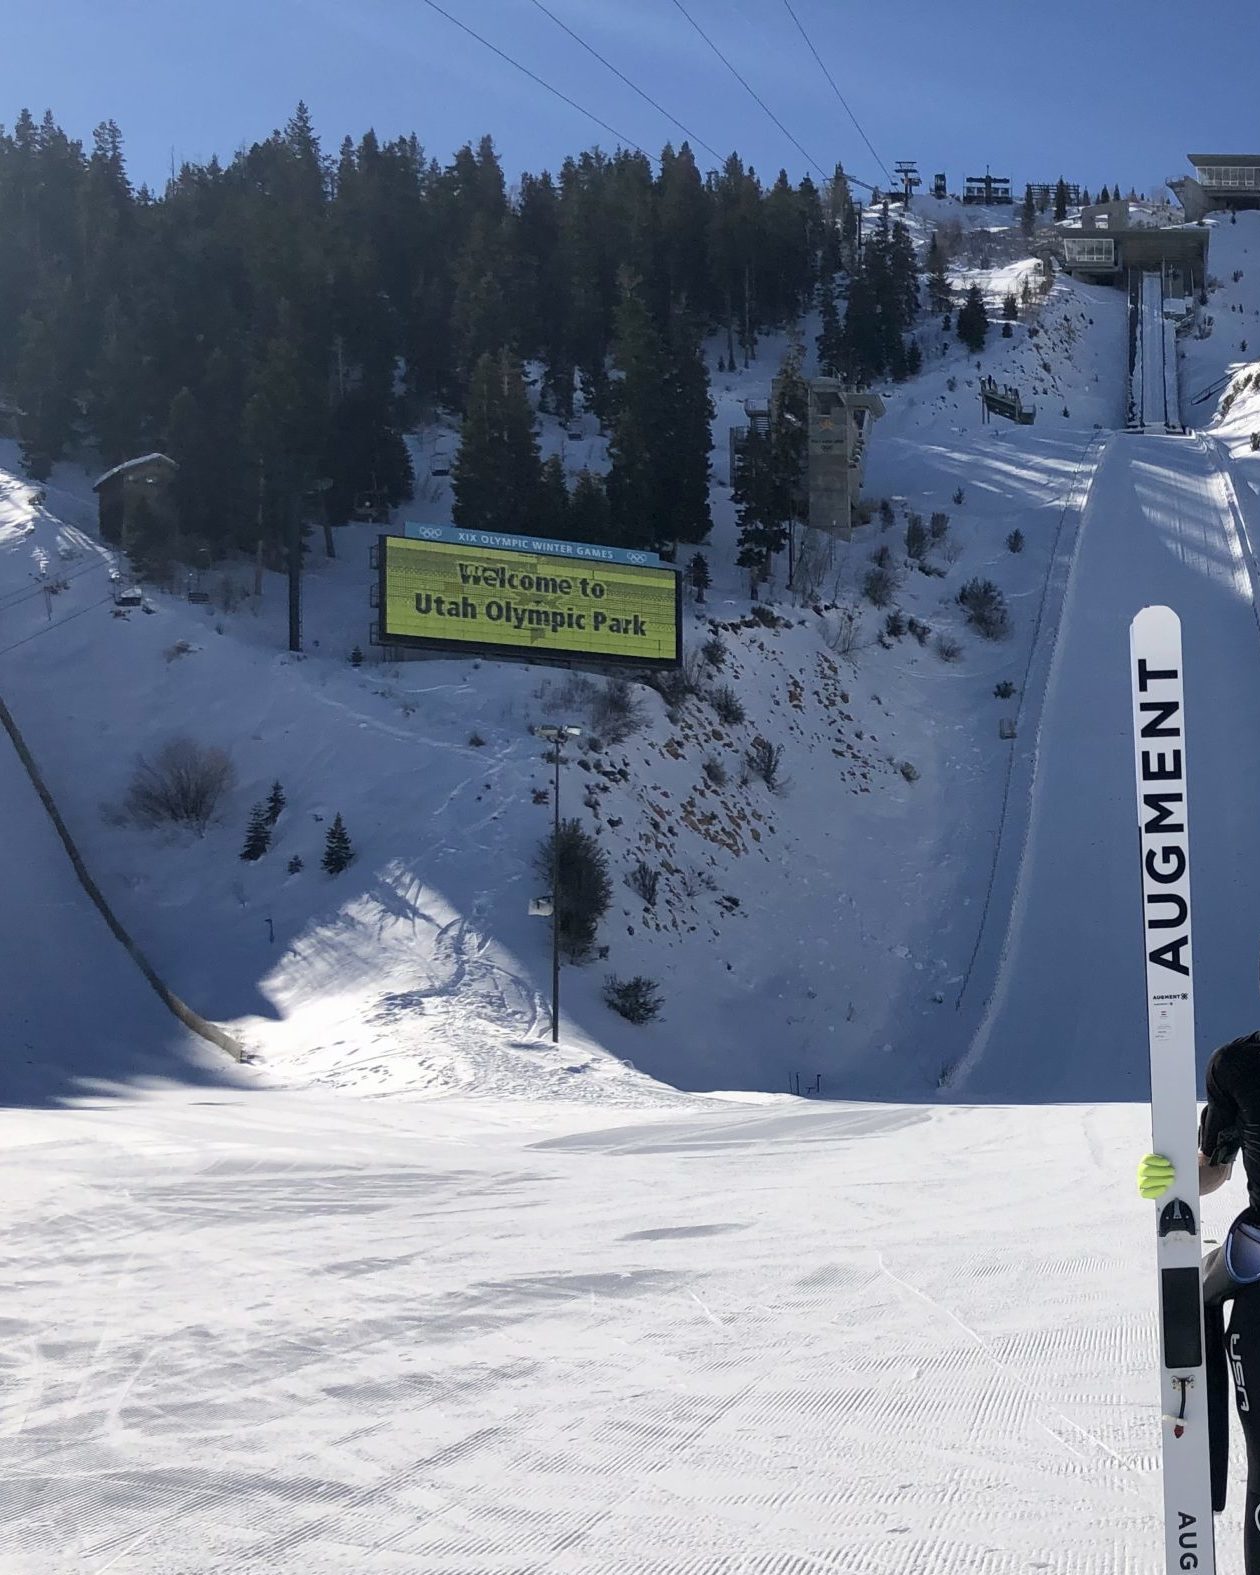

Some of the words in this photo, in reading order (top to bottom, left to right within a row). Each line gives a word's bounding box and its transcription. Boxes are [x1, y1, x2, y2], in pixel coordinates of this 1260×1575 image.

[458, 532, 477, 542] XIX
[481, 535, 529, 549] OLYMPIC
[532, 541, 573, 554] WINTER
[576, 547, 614, 559] GAMES
[459, 563, 573, 594] Welcome
[579, 577, 606, 599] to
[415, 592, 478, 620] Utah
[485, 600, 586, 633] Olympic
[592, 611, 647, 637] Park
[1138, 658, 1190, 977] AUGMENT
[1230, 1333, 1249, 1411] USA
[1178, 1511, 1199, 1571] AUG
